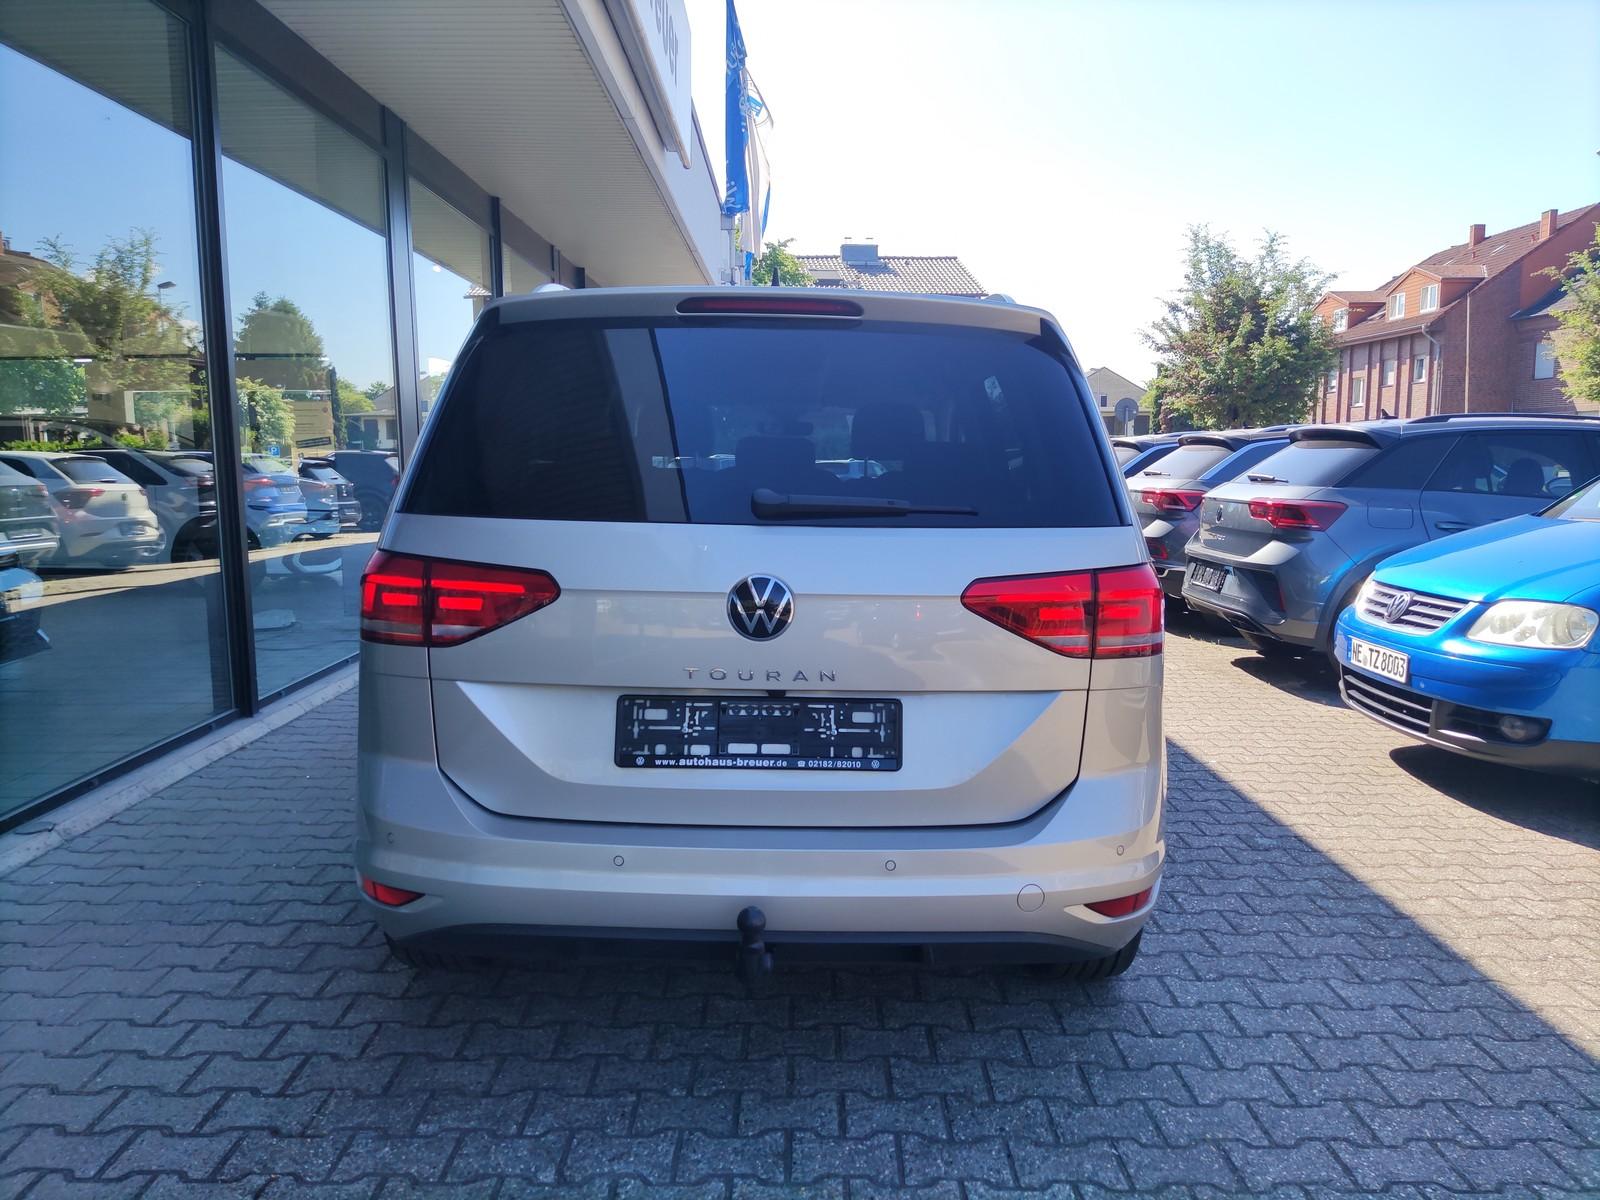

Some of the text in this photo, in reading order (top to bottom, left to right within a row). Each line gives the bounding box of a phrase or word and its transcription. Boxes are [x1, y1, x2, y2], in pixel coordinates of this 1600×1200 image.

[650, 0, 679, 87] euer
[1352, 642, 1405, 678] NE TZ 8003
[683, 667, 836, 682] TOURAN
[654, 757, 788, 768] www.autohaus-breuer.de
[808, 759, 862, 769] 02182/82010
